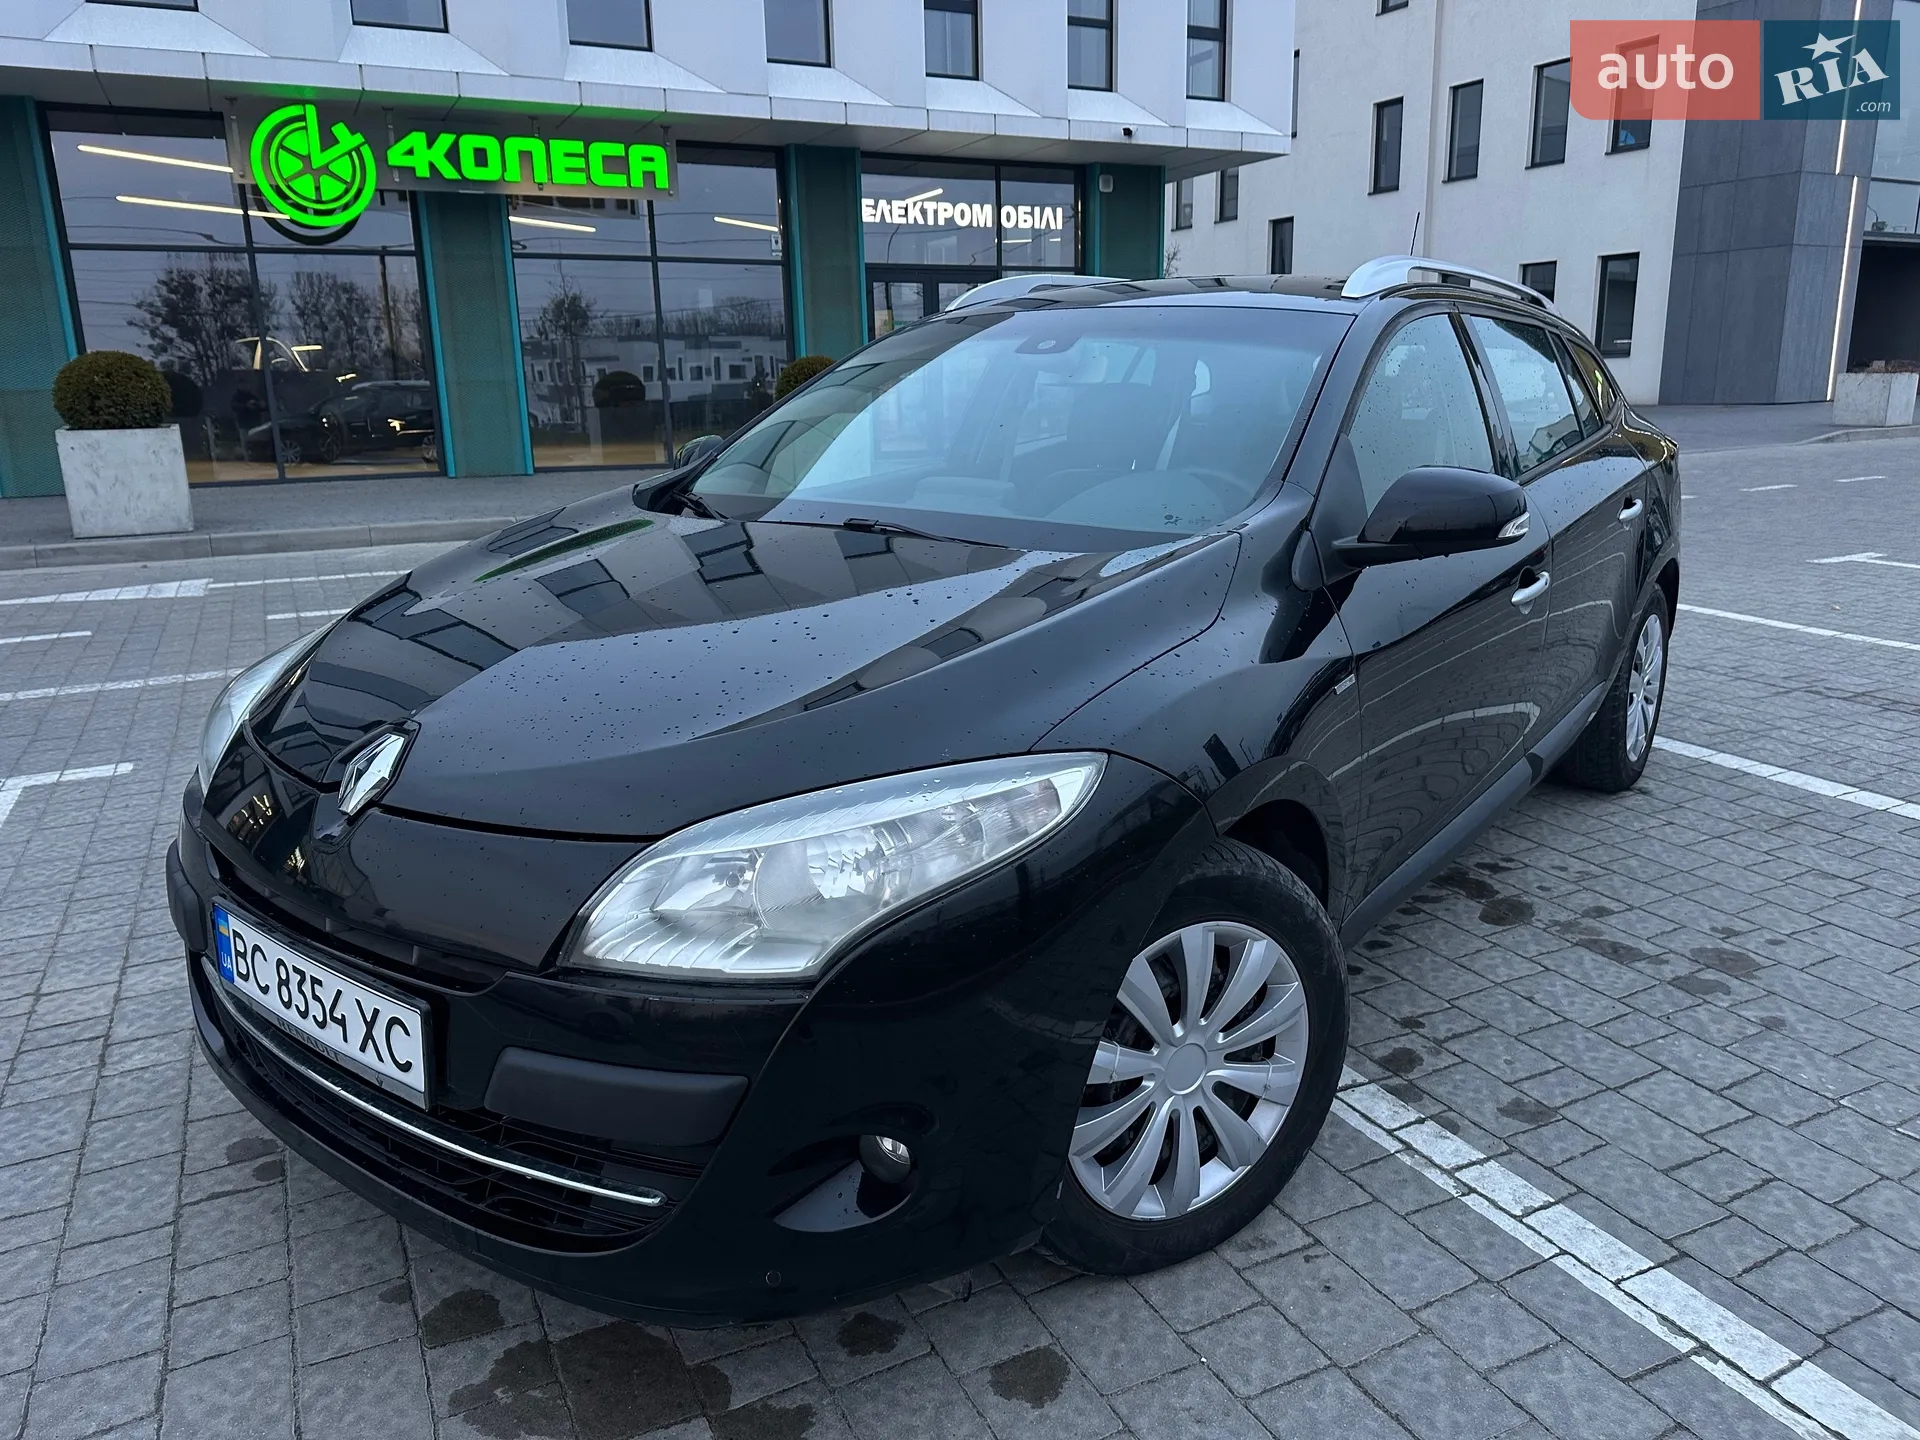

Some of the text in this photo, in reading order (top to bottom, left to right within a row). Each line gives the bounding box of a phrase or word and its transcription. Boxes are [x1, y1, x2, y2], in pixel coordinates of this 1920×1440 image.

[221, 952, 232, 971] UA
[232, 928, 413, 1074] BC 8354 XC
